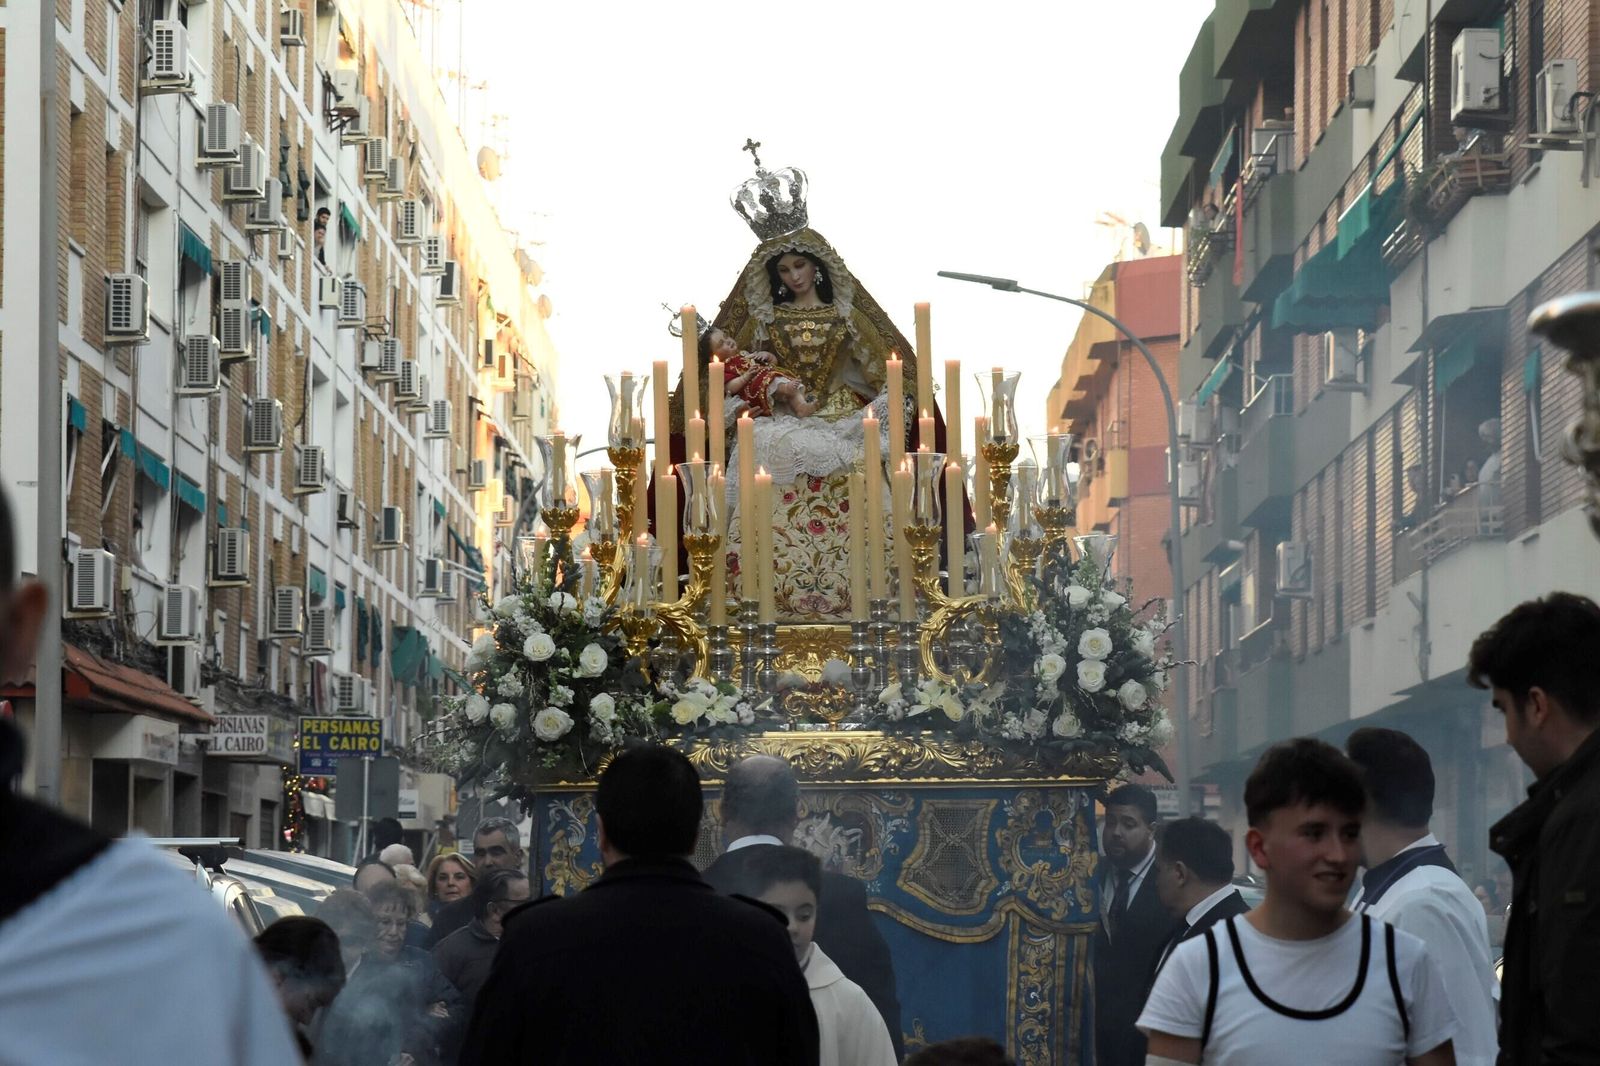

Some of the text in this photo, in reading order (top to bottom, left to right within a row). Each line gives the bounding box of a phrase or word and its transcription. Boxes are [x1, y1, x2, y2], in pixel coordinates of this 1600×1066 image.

[212, 717, 265, 733] ERSIANAS
[303, 719, 380, 735] PERSIANAS
[225, 736, 264, 751] CAIRO
[303, 736, 321, 750] EL
[329, 736, 380, 751] CAIRO
